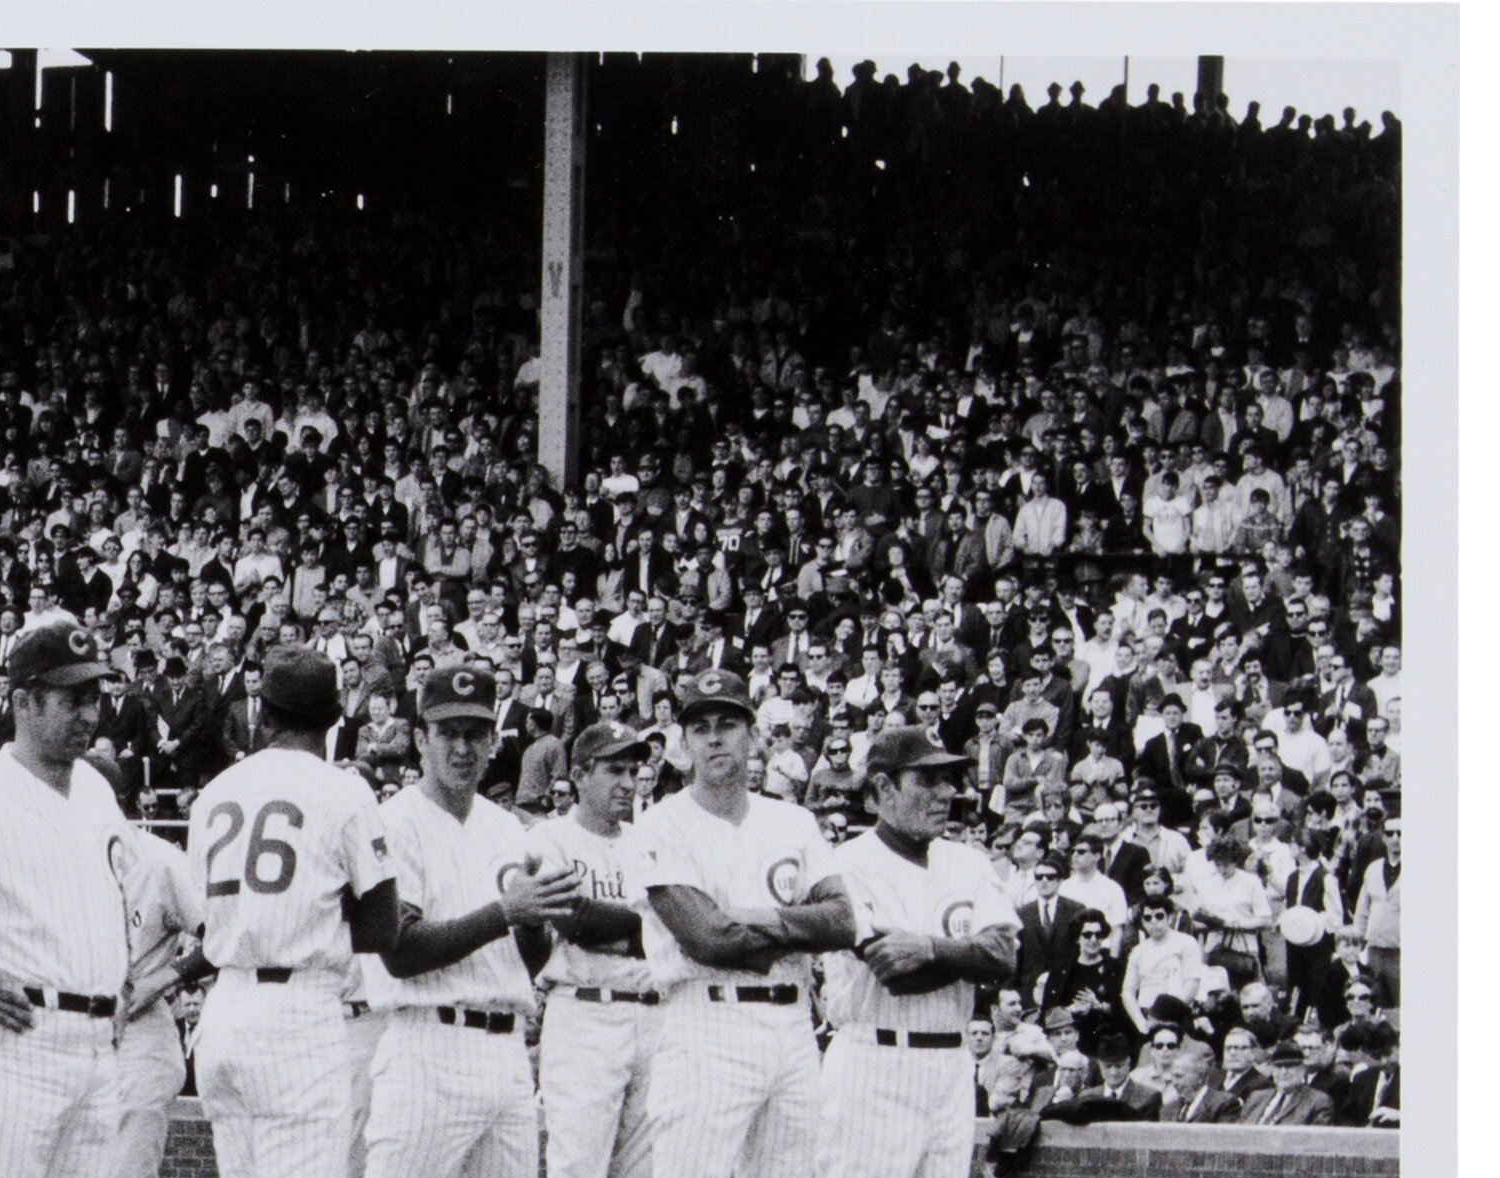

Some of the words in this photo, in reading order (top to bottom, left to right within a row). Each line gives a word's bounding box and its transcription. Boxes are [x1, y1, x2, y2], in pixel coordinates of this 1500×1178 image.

[717, 534, 740, 551] 70
[68, 629, 89, 655] C
[452, 671, 475, 696] C
[699, 673, 722, 695] C
[206, 799, 304, 899] 26
[767, 858, 800, 908] CUB
[942, 901, 975, 939] CUB
